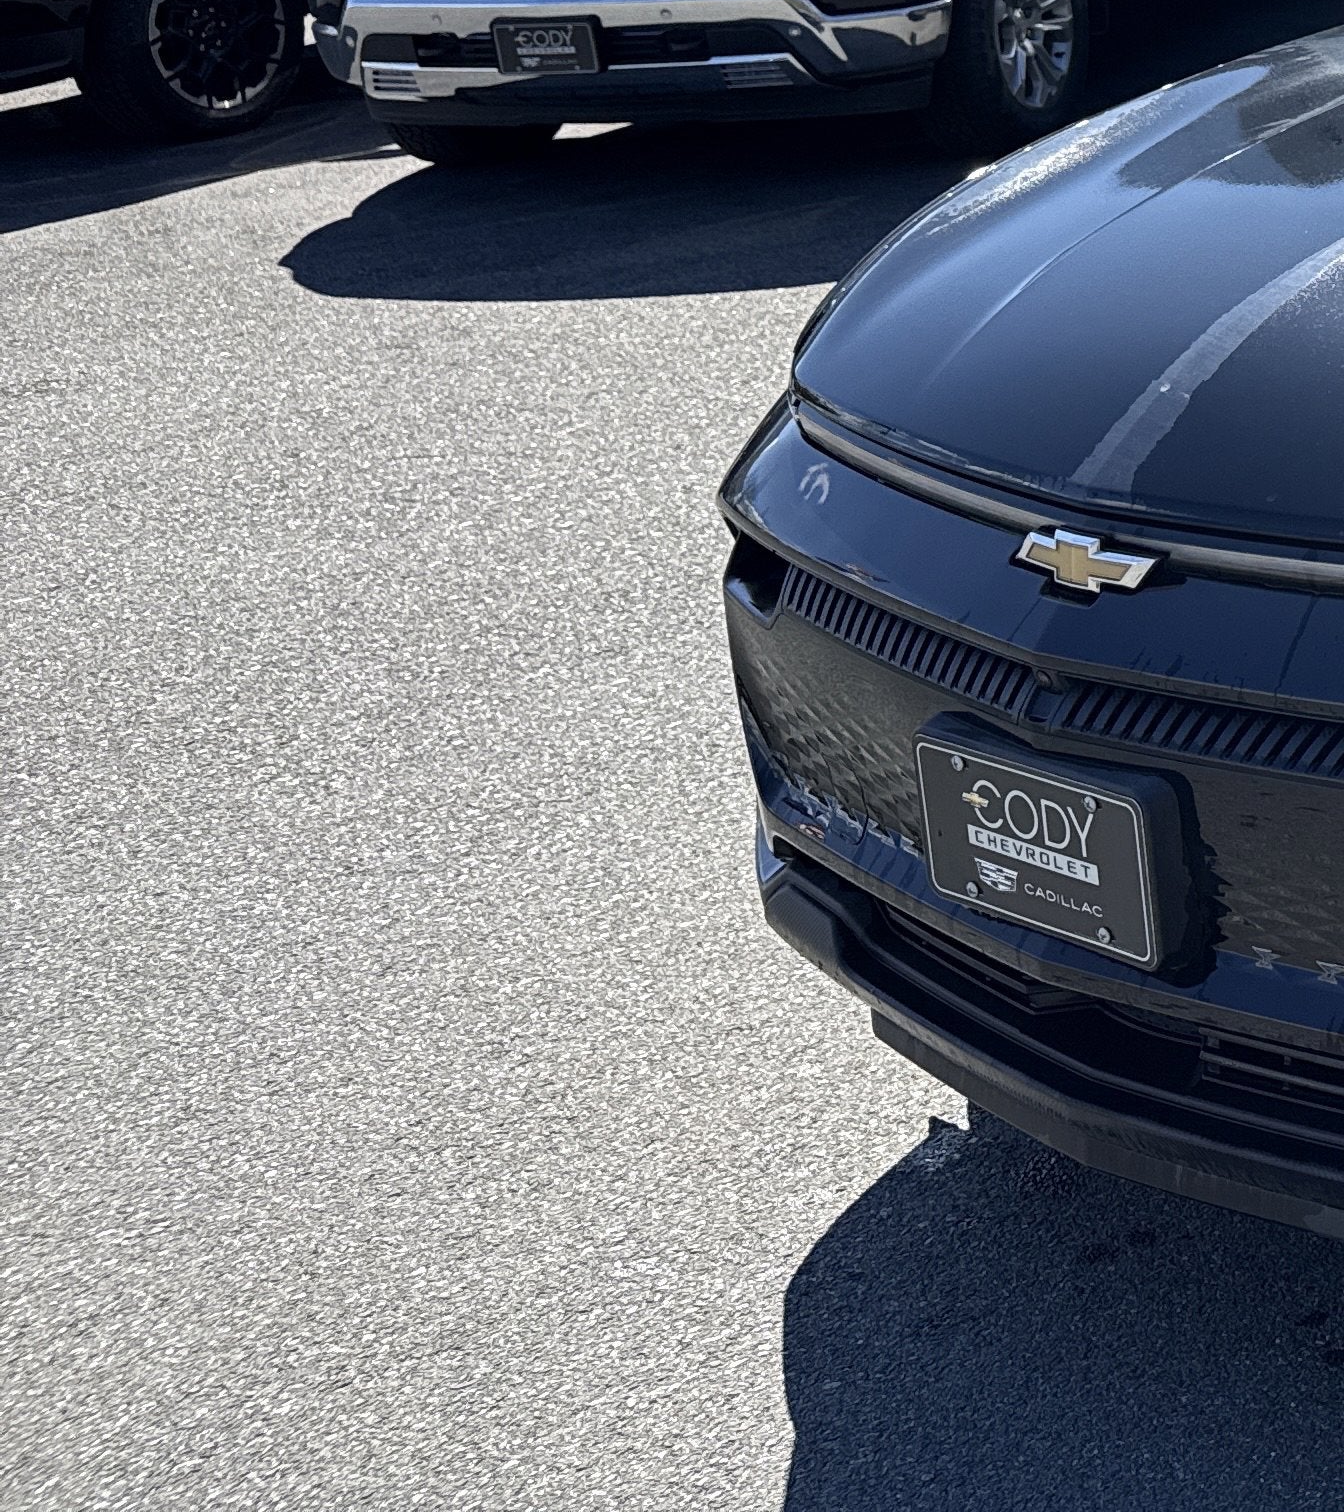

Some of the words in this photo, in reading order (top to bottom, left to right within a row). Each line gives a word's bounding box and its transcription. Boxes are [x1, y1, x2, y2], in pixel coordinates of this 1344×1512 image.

[518, 29, 573, 47] CODY
[970, 779, 1096, 858] CODY
[973, 829, 1092, 880] CHEVROLET
[1024, 882, 1104, 919] CADILLAC
